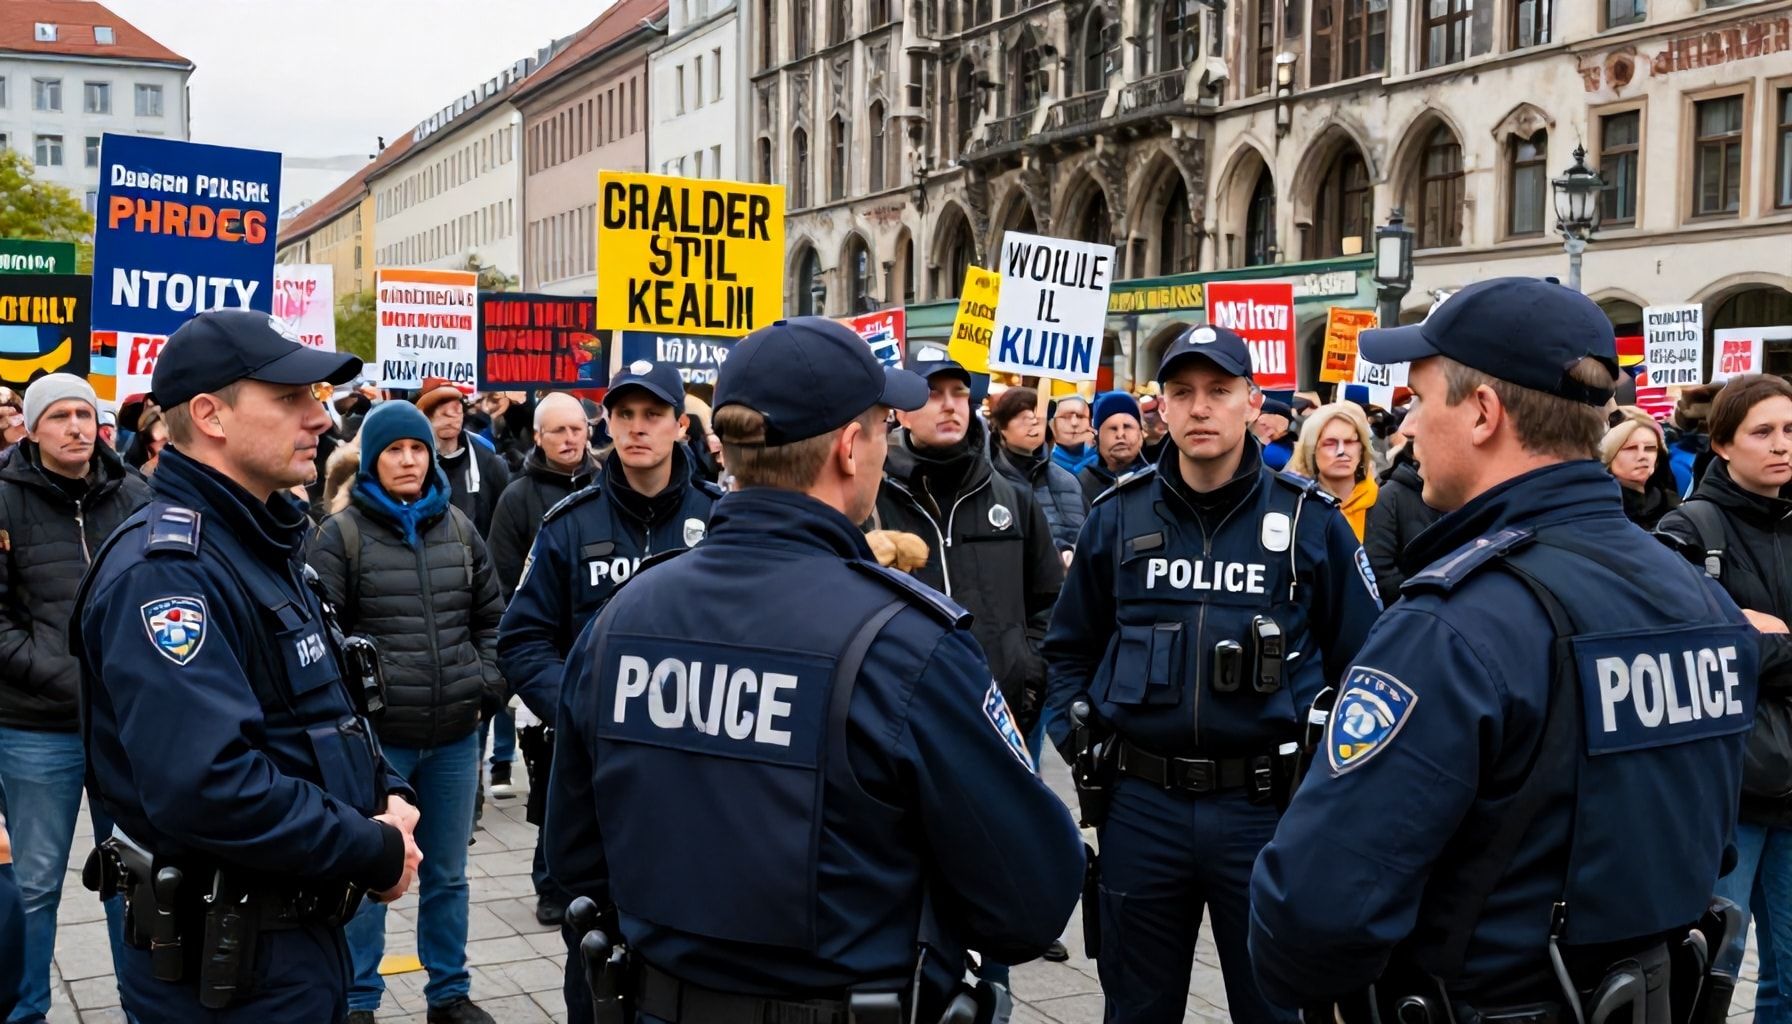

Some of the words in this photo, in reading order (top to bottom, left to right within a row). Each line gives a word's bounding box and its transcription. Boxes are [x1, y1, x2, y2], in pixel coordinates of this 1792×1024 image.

[603, 181, 771, 241] CRALDER
[1146, 558, 1266, 594] POLICE
[1595, 646, 1743, 733] POLICE
